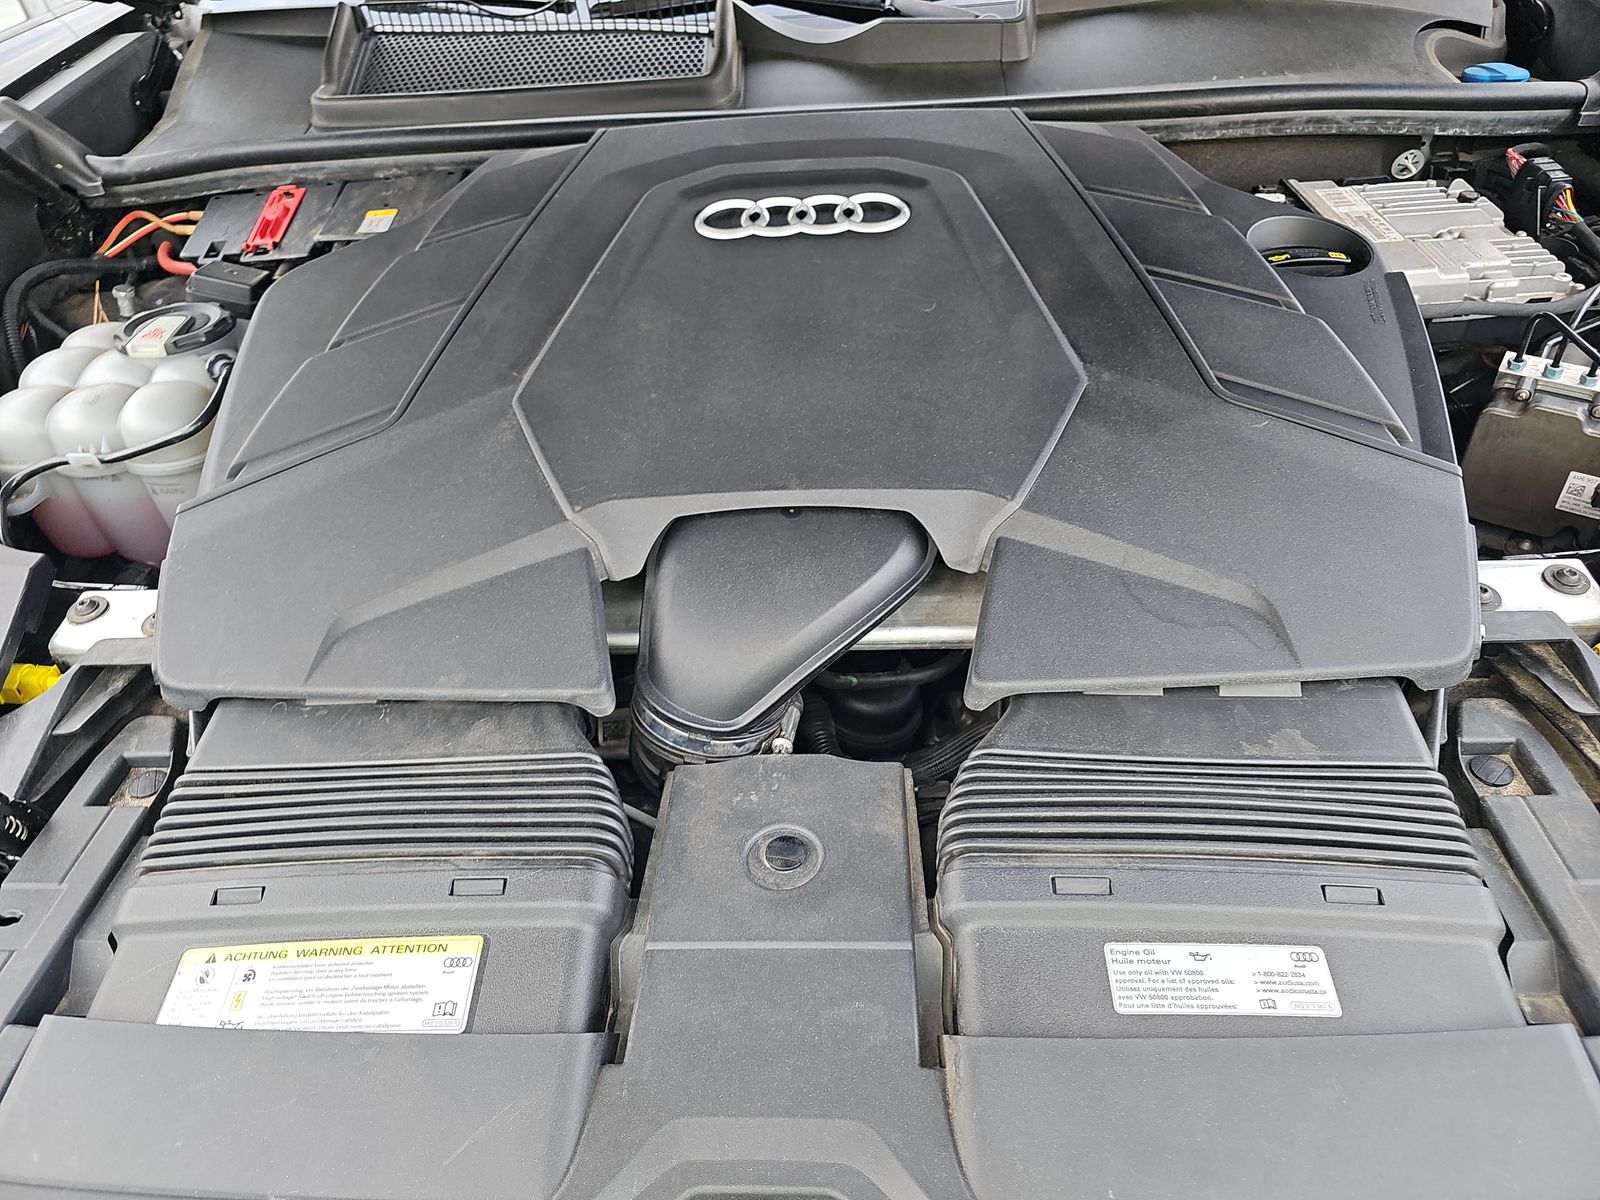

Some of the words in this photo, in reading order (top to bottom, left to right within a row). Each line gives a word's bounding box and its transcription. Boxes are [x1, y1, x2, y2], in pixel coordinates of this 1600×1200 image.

[224, 948, 288, 962] ACHTUNG
[296, 946, 363, 958] WARNING
[370, 942, 448, 955] ATTENTION
[1109, 948, 1141, 957] Engine
[1142, 948, 1156, 956] Oil
[1111, 957, 1135, 965] Huile
[1127, 969, 1143, 977] only
[1114, 977, 1146, 985] approval.
[1187, 977, 1220, 985] approved
[1170, 994, 1214, 1002] approbation.
